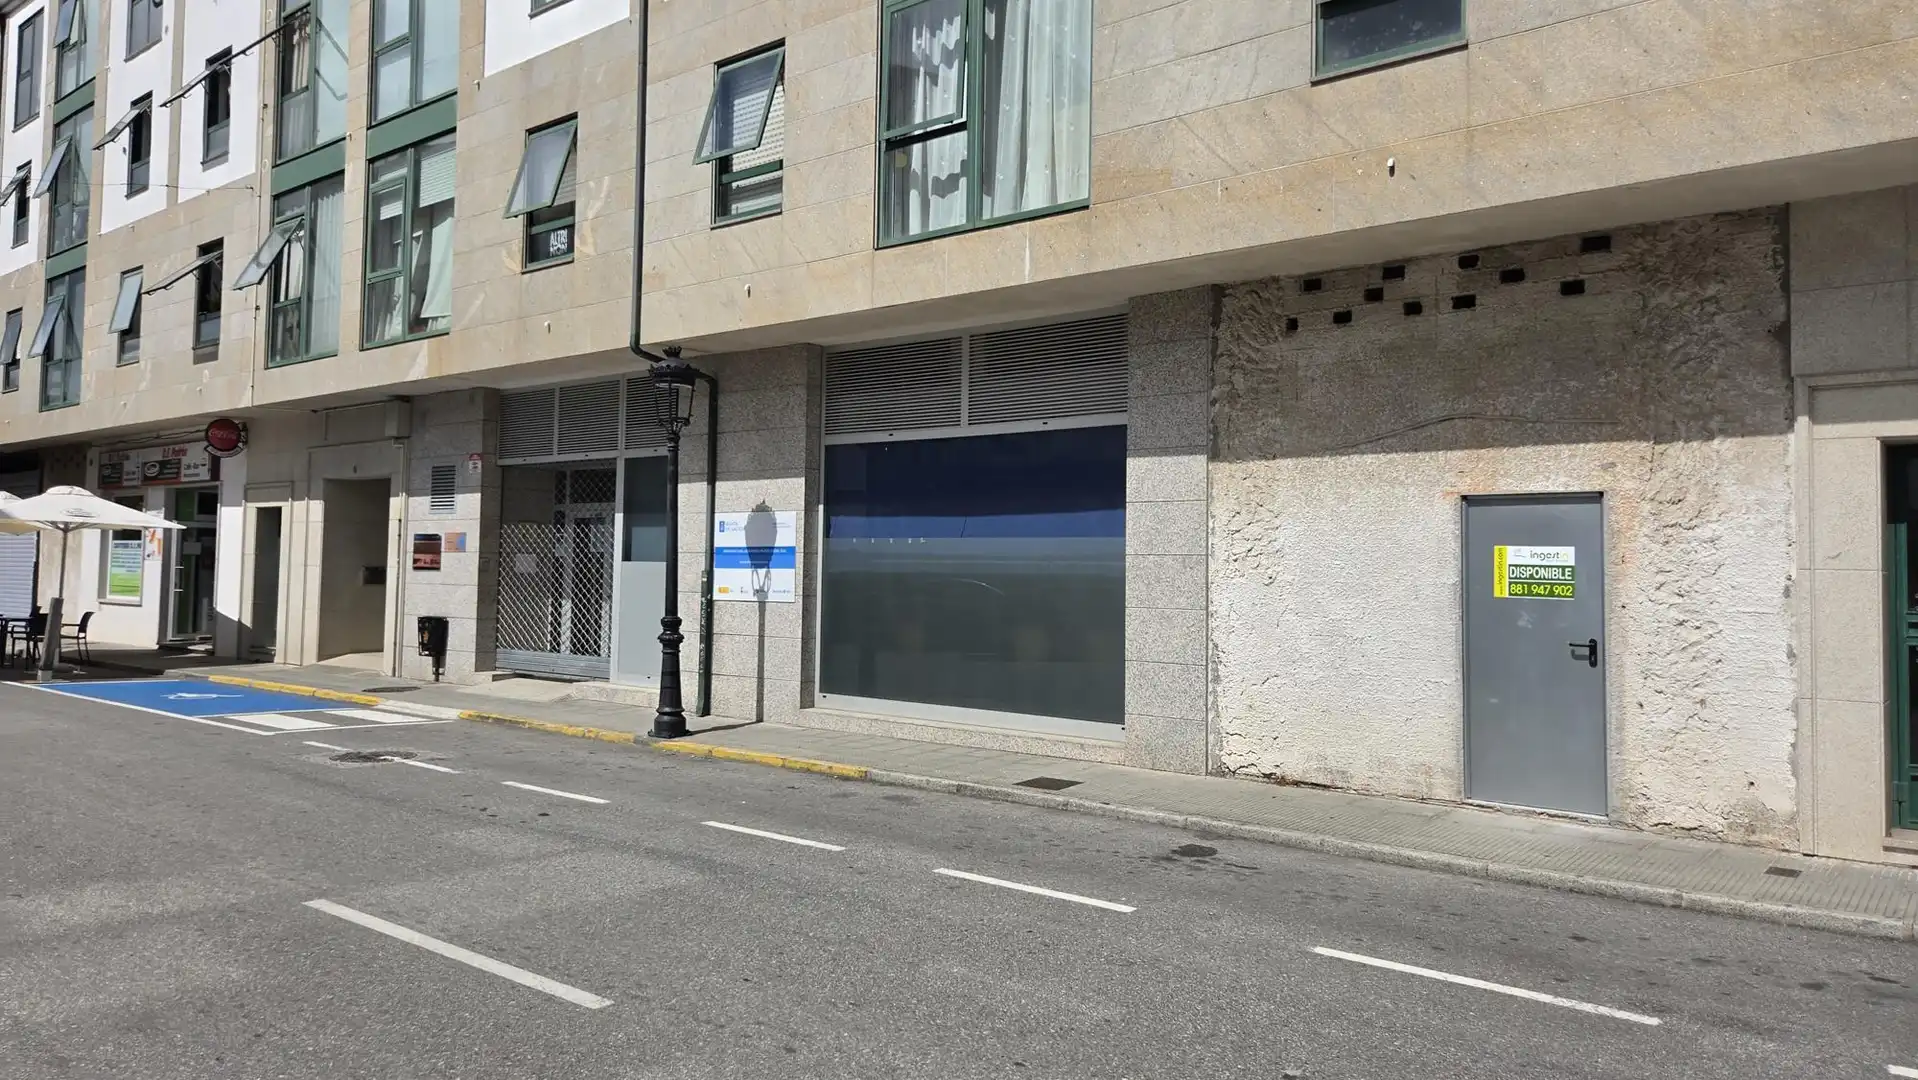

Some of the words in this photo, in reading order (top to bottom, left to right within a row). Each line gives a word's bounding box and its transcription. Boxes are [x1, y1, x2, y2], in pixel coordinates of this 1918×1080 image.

[550, 228, 568, 247] ALTRI
[1509, 567, 1572, 579] DISPONIBLE
[1510, 584, 1528, 594] 881
[1531, 584, 1551, 595] 947
[1553, 585, 1573, 596] 902
